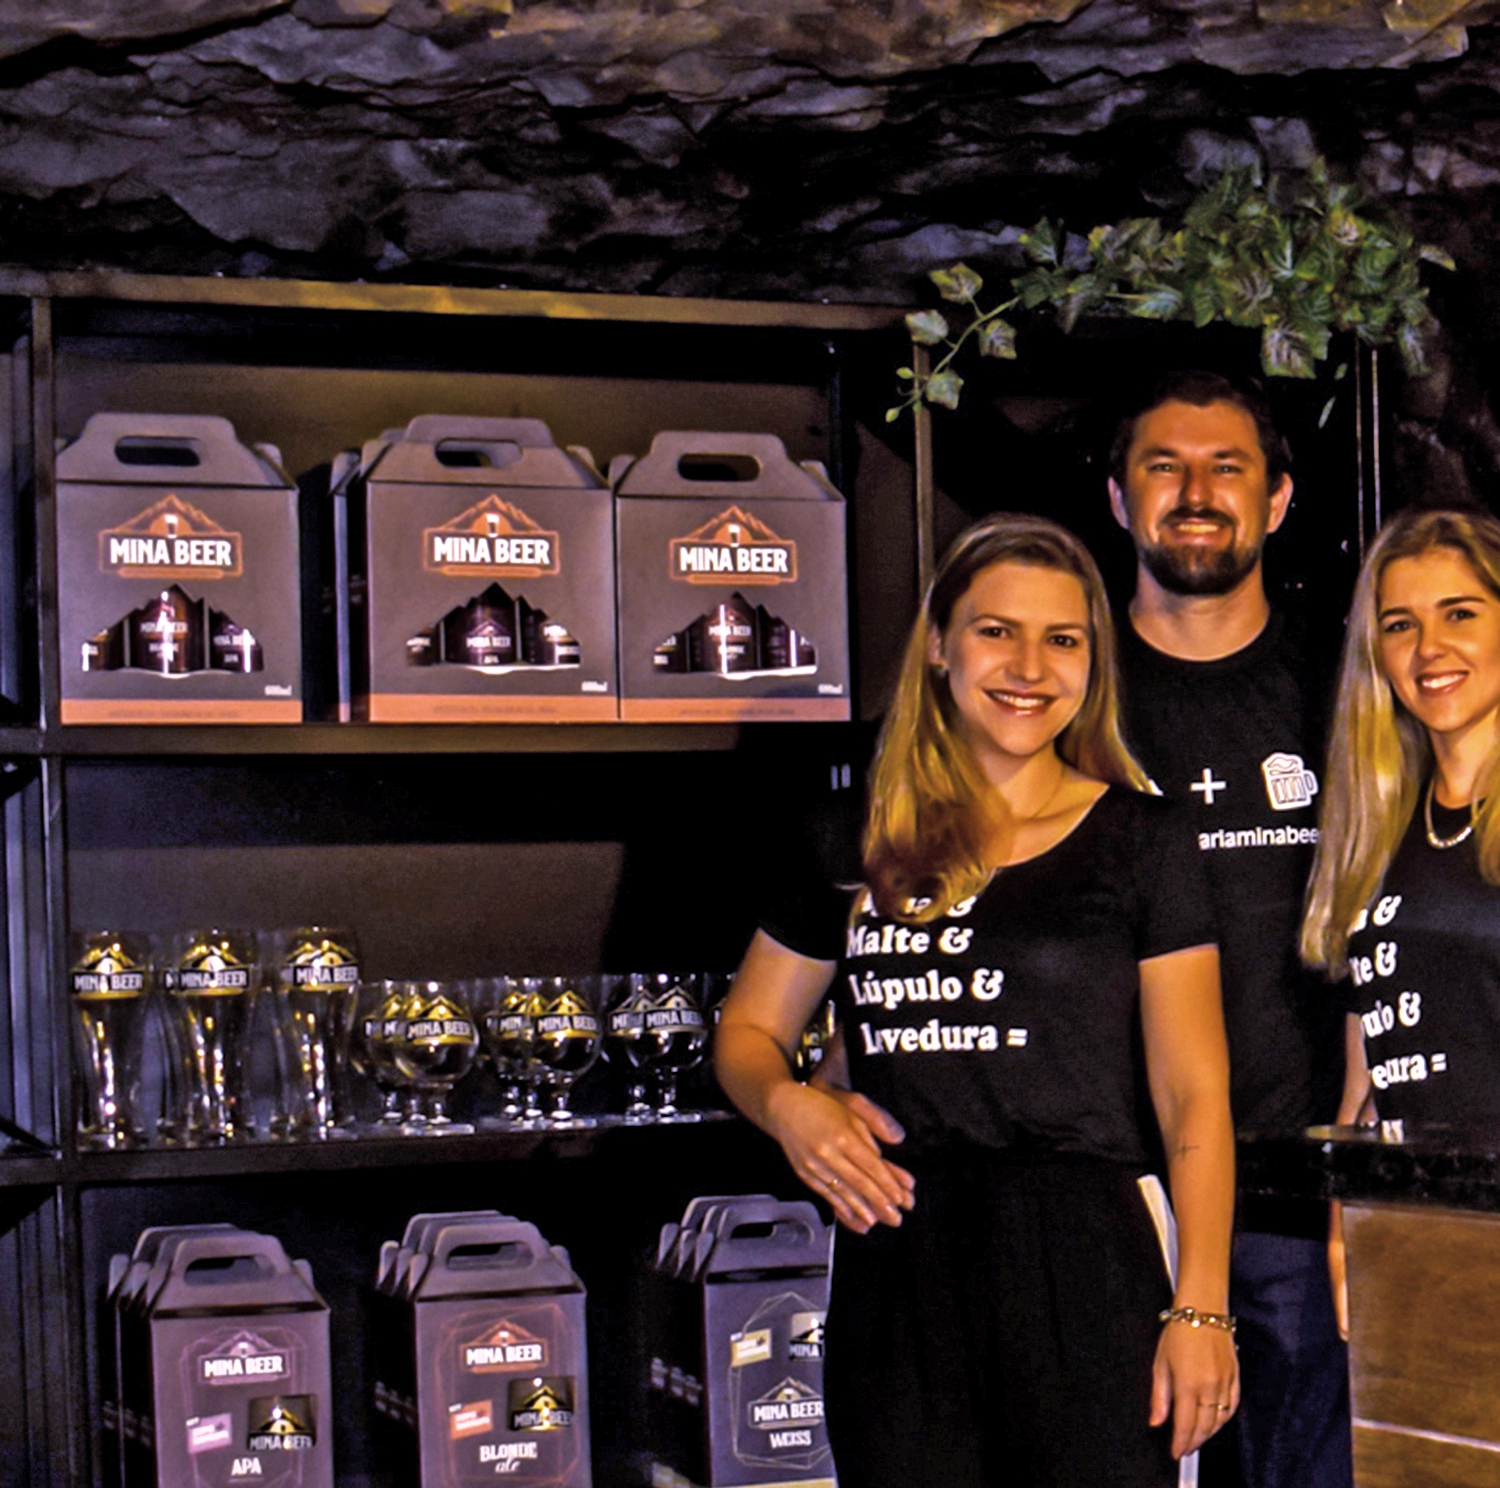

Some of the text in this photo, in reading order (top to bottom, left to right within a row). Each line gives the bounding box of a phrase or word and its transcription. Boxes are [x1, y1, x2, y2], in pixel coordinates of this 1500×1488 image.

[110, 538, 232, 567] MINA BEER
[434, 537, 550, 565] MINA BEER
[680, 547, 788, 573] MINA BEER
[1373, 895, 1402, 926] &
[846, 924, 974, 959] Malte &
[1375, 942, 1397, 977] &
[74, 973, 143, 992] MINA BEER
[180, 971, 211, 989] MINA
[214, 970, 248, 987] BEER
[296, 966, 331, 984] MINA
[848, 968, 1004, 1010] Lúpulo &
[1399, 991, 1421, 1026] &
[407, 1021, 442, 1039] MINA
[538, 1014, 570, 1032] MINA
[647, 1011, 680, 1029] MINA
[1007, 1029, 1028, 1046] =
[1431, 1052, 1447, 1072] =
[466, 1344, 542, 1366] MINA BEER
[204, 1355, 283, 1377] MINA BEER
[754, 1401, 824, 1423] MINA BEER
[769, 1430, 812, 1449] WEISS
[480, 1442, 538, 1462] BLONDE
[231, 1457, 262, 1476] APA
